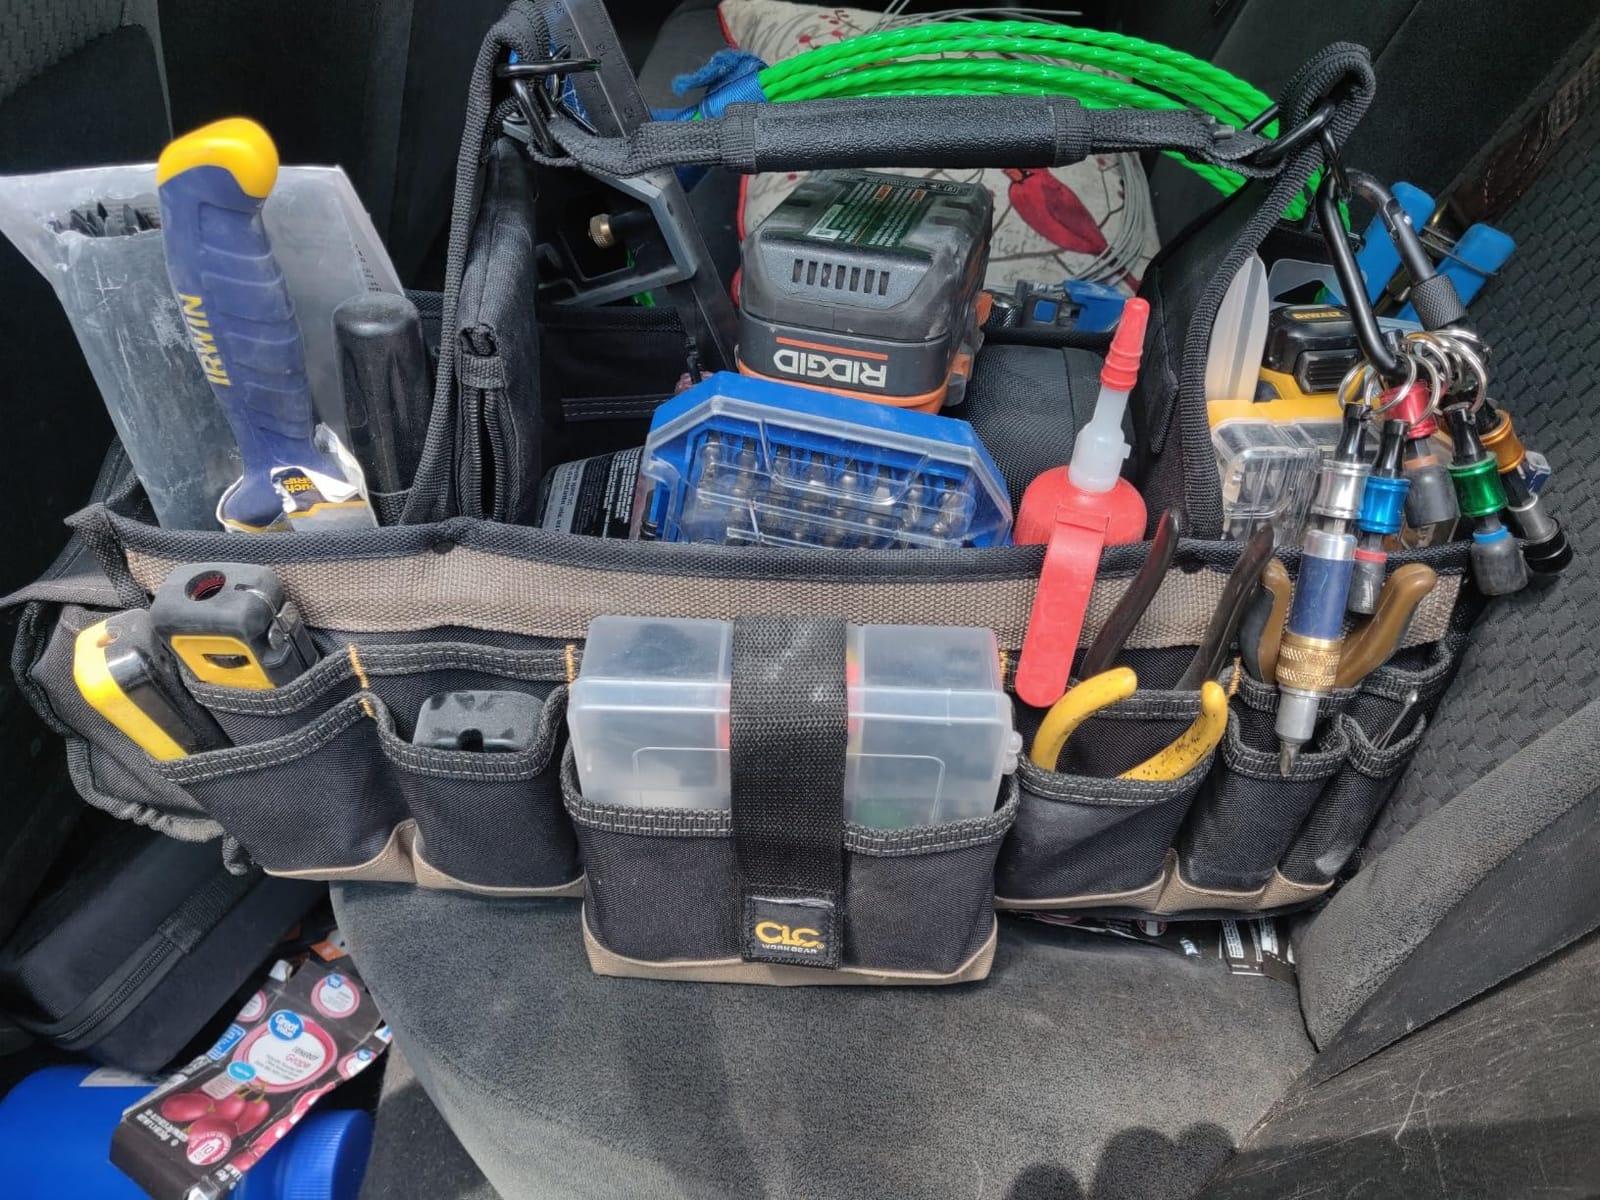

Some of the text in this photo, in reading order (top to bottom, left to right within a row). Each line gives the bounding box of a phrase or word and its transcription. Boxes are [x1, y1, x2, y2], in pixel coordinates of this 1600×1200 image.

[178, 293, 231, 386] IRWIN
[773, 349, 887, 388] RIDGID
[286, 483, 316, 493] ouch
[756, 921, 819, 948] CLC
